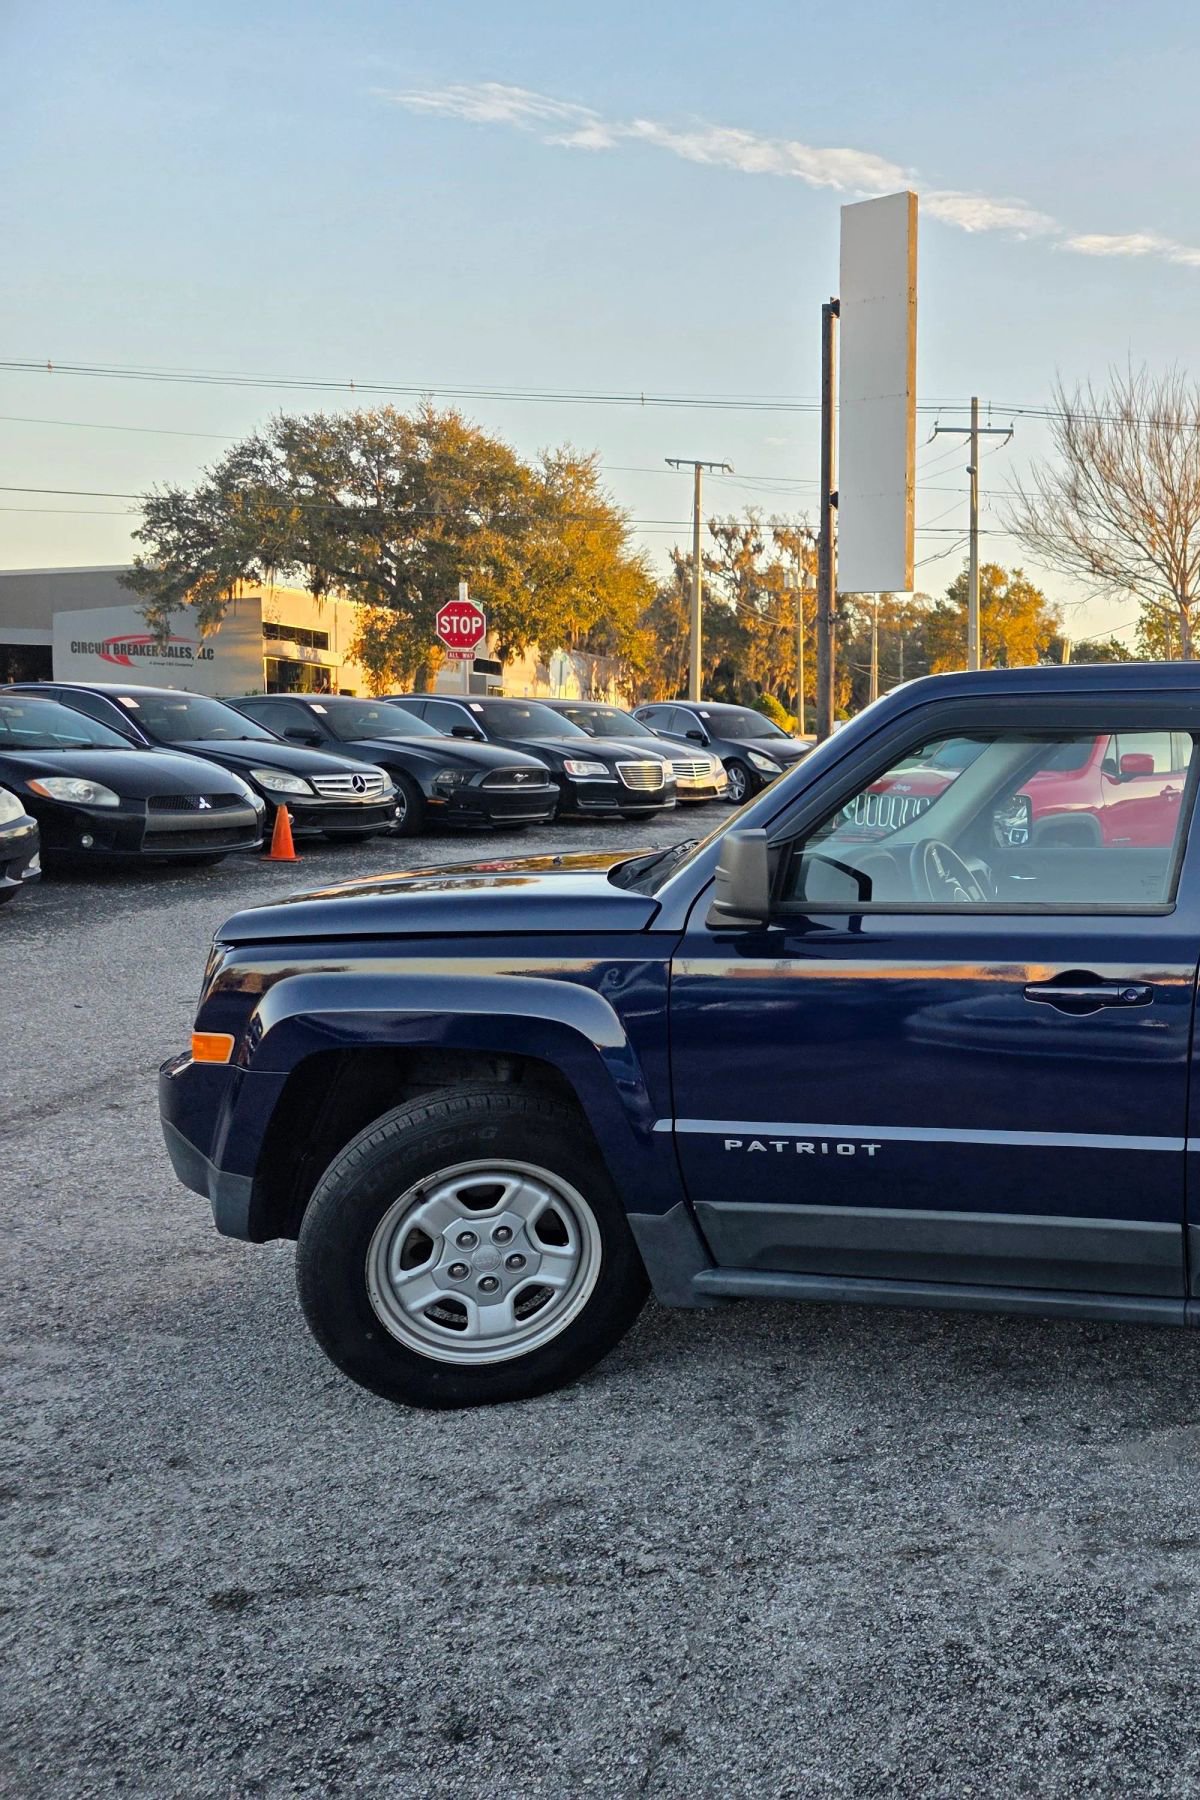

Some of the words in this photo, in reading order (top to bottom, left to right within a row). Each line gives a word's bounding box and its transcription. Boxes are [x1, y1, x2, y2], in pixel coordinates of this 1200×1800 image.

[440, 615, 482, 635] STOP
[70, 641, 110, 655] CIRCUIT
[113, 643, 159, 657] BREAKER
[160, 646, 195, 661] SALES,
[724, 1139, 882, 1156] PATRIOT
